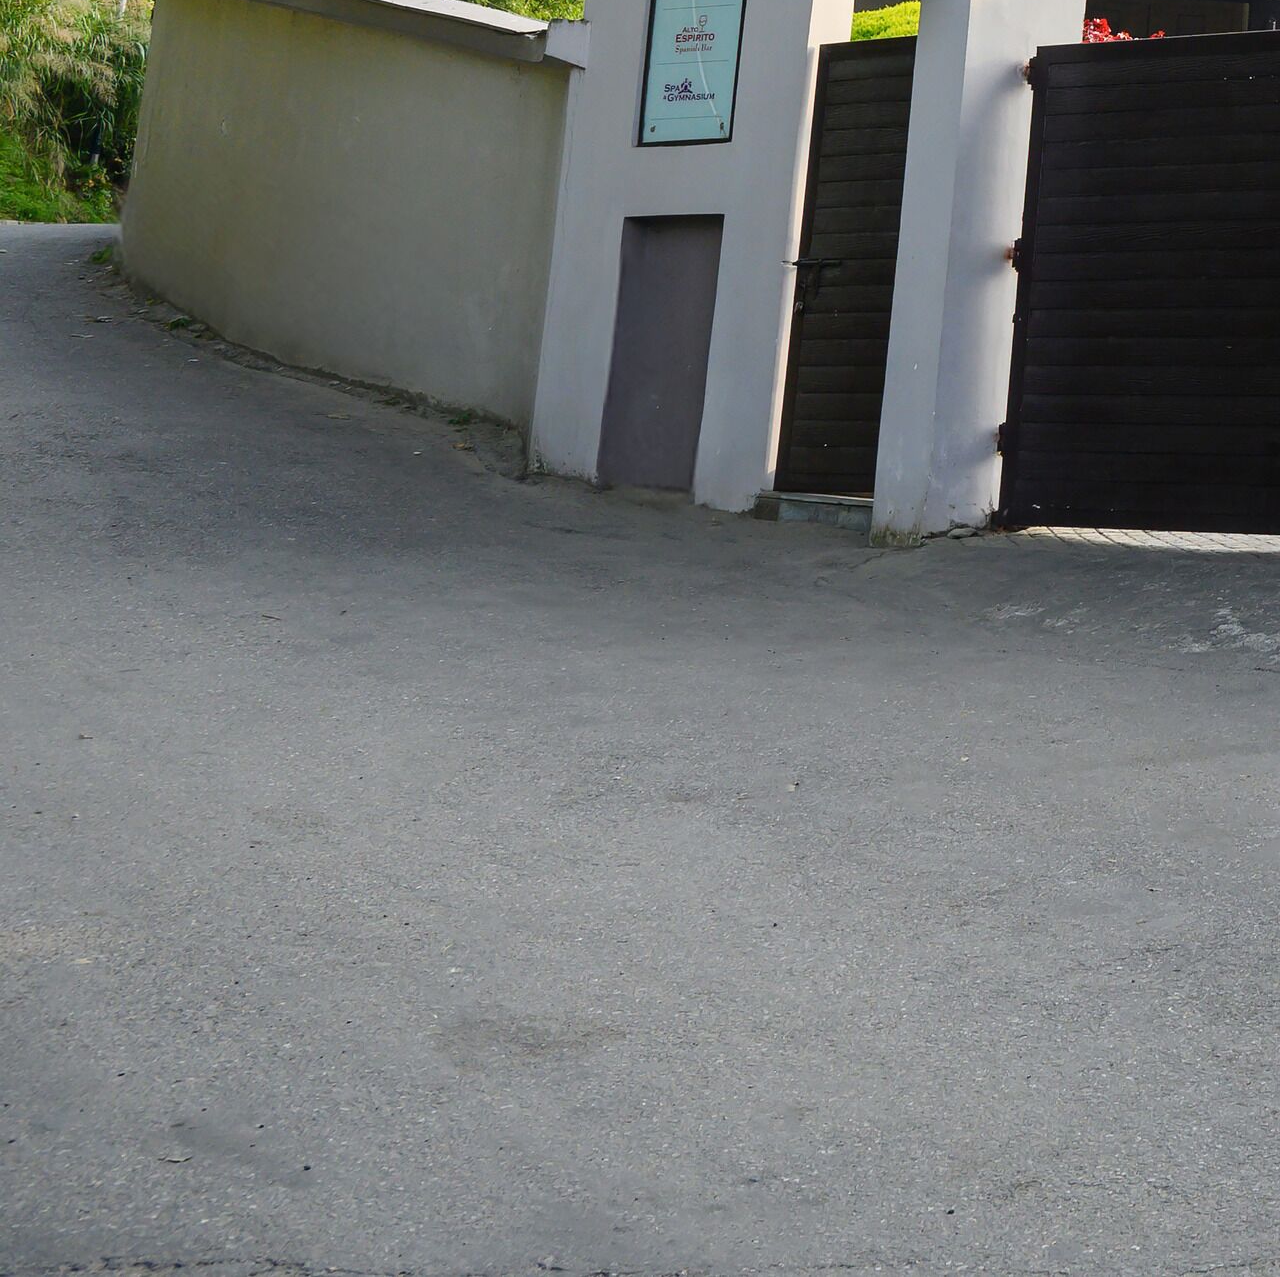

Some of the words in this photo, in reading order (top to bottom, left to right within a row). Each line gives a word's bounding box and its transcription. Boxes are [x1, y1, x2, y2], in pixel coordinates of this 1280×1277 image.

[675, 33, 715, 43] ESPIRITO
[664, 84, 680, 92] SPA
[668, 93, 715, 102] GYMNASIUM
